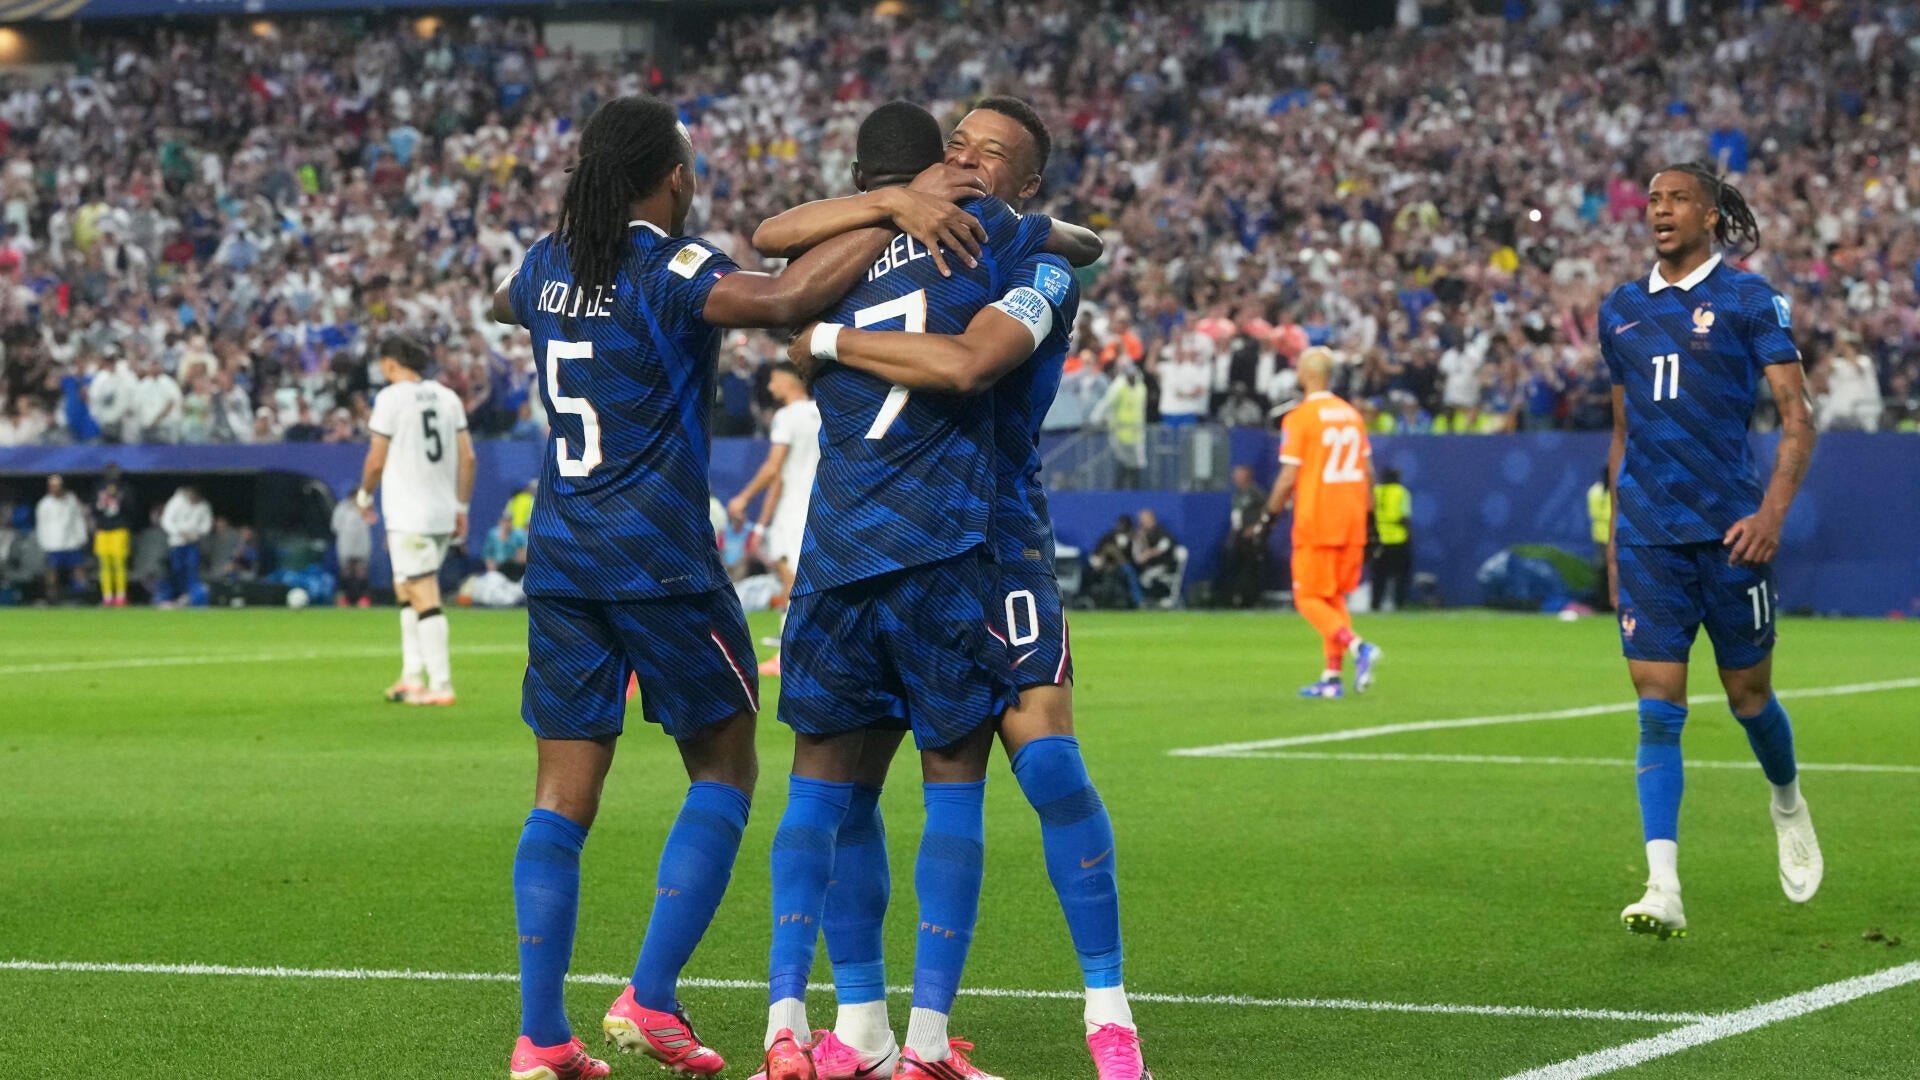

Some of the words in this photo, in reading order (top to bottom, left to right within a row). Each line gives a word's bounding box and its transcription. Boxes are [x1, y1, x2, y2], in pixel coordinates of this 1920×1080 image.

[1010, 294, 1042, 319] UNITES
[1015, 288, 1046, 313] FOOTBALL
[855, 288, 927, 440] 7
[1651, 353, 1680, 402] 11
[546, 340, 603, 478] 5
[421, 408, 443, 464] 5
[1321, 426, 1365, 484] 22
[1746, 580, 1770, 630] 11
[779, 912, 813, 926] FFF
[920, 921, 957, 939] FFF
